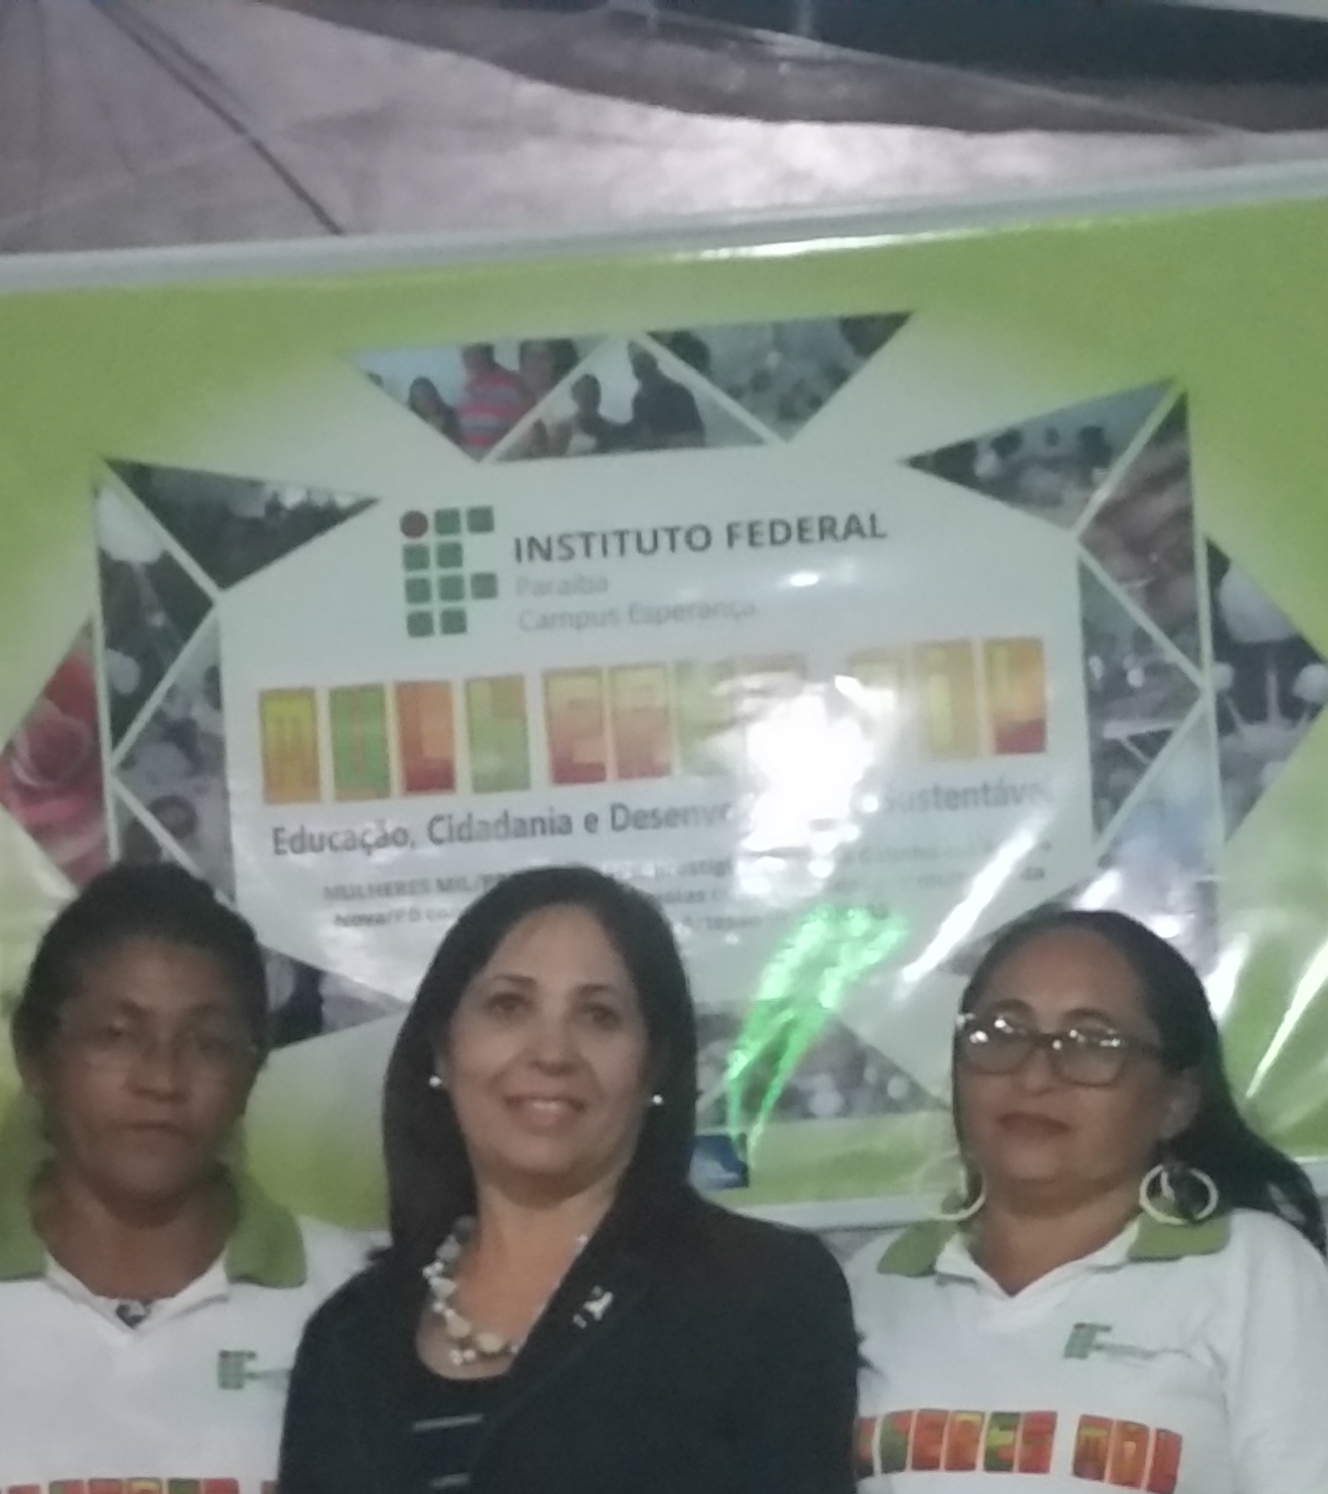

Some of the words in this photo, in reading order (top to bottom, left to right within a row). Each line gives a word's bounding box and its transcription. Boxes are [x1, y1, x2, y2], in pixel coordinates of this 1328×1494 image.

[513, 523, 713, 564] INSTITUTO
[725, 511, 889, 551] FEDERAL
[517, 605, 621, 633] Campus
[627, 599, 758, 629] Esperança
[272, 817, 418, 858] Educação,
[426, 805, 574, 847] Cidadania
[582, 810, 600, 835] e
